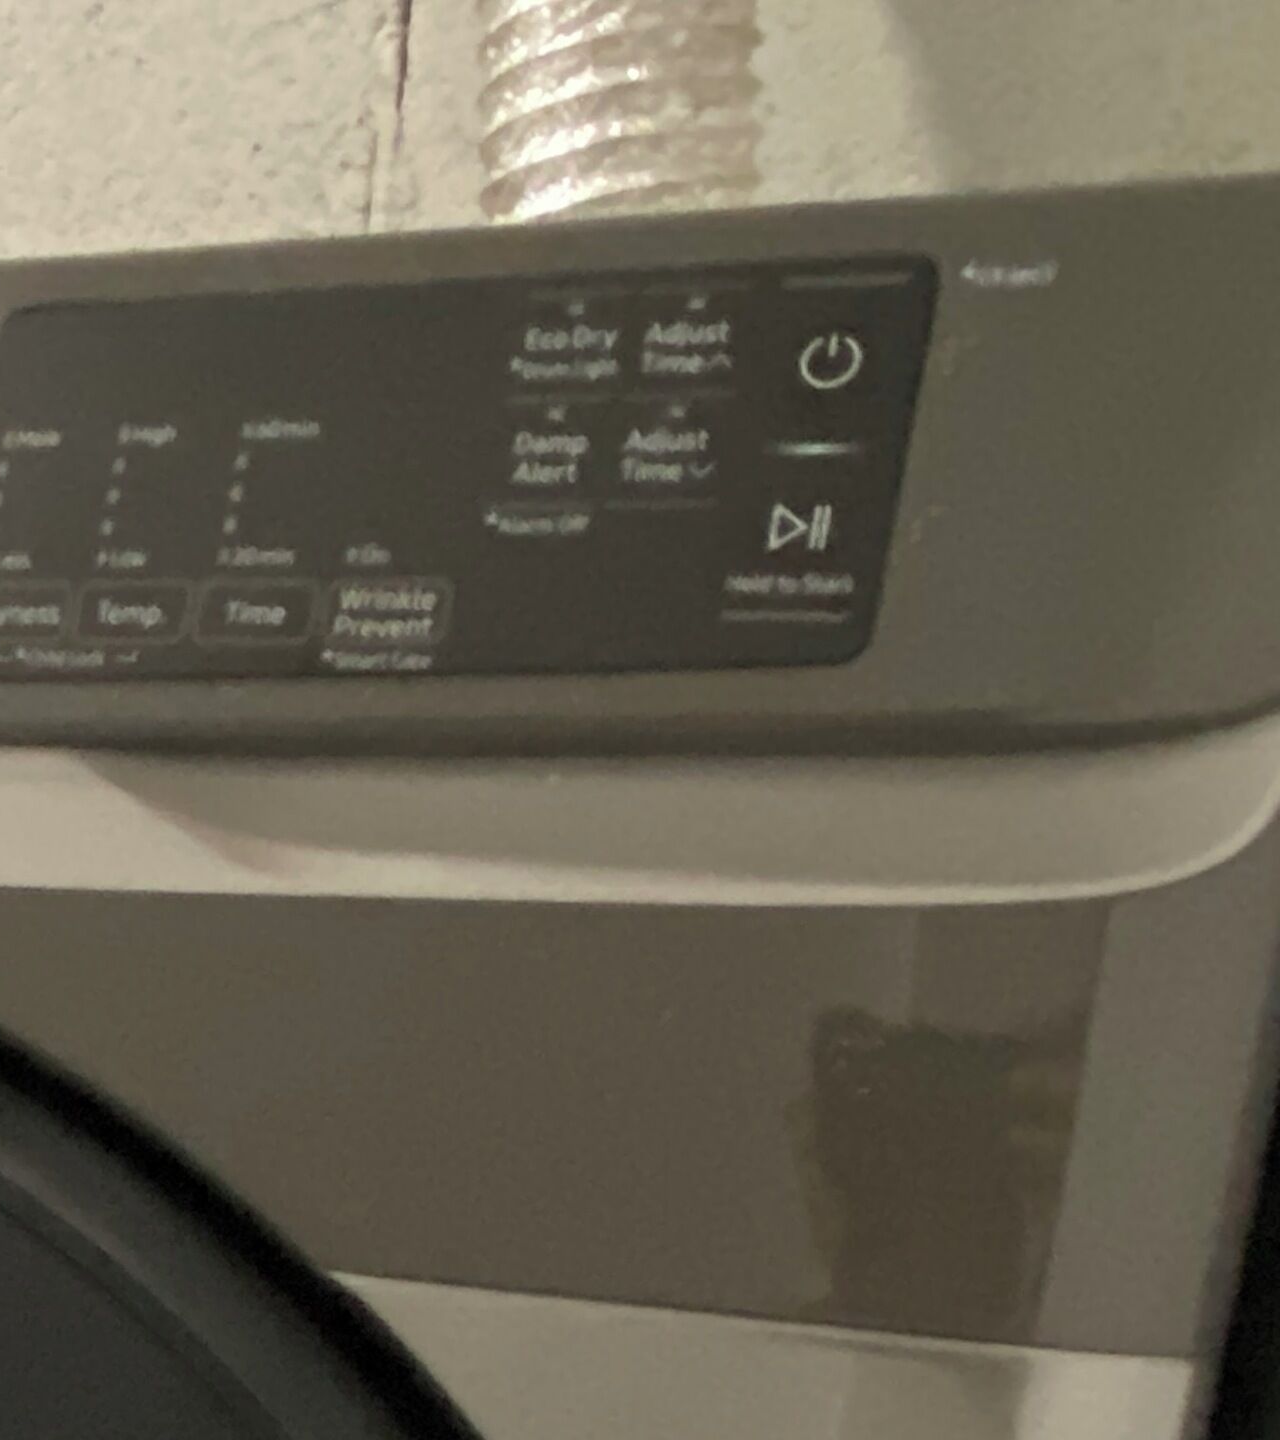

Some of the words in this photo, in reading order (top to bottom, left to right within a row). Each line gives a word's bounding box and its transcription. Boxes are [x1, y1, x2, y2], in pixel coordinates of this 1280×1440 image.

[523, 326, 570, 350] Eco
[572, 323, 621, 351] Dry
[643, 319, 730, 346] Adjust
[512, 430, 590, 457] Damp
[623, 428, 710, 452] Adjust
[510, 461, 577, 485] Alert
[340, 587, 437, 611] Wrinkle
[333, 614, 434, 638] Prevent
